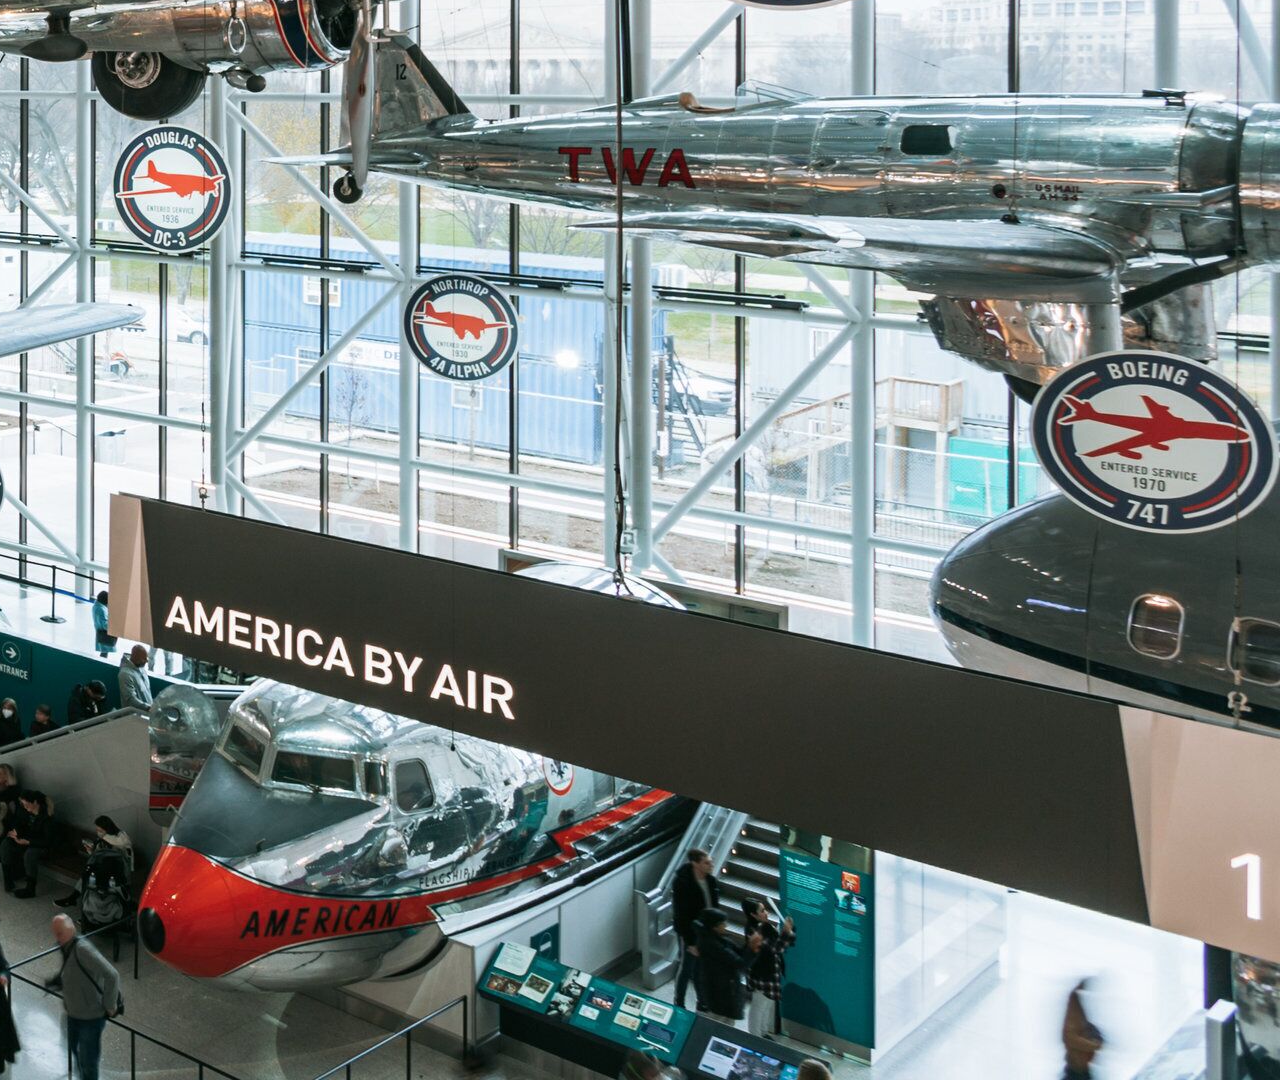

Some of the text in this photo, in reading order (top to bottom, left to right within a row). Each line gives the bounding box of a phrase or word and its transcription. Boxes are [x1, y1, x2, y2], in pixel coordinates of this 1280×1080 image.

[395, 63, 408, 81] 12
[145, 131, 197, 149] DOUGLAS
[557, 146, 697, 190] TWA
[146, 205, 194, 215] ENTERED SERVICE
[162, 214, 180, 224] 1936
[153, 229, 187, 247] DC-3
[431, 279, 489, 297] NORTHROP
[429, 356, 492, 378] 4A ALPHA
[1106, 361, 1190, 387] BOEING
[1100, 461, 1199, 482] ENTERED SERVICE
[1132, 476, 1166, 492] 1970
[1126, 499, 1169, 525] 747
[164, 595, 516, 720] AMERICA BY AIR
[1230, 852, 1262, 921] 1
[239, 900, 402, 940] AMERICAN
